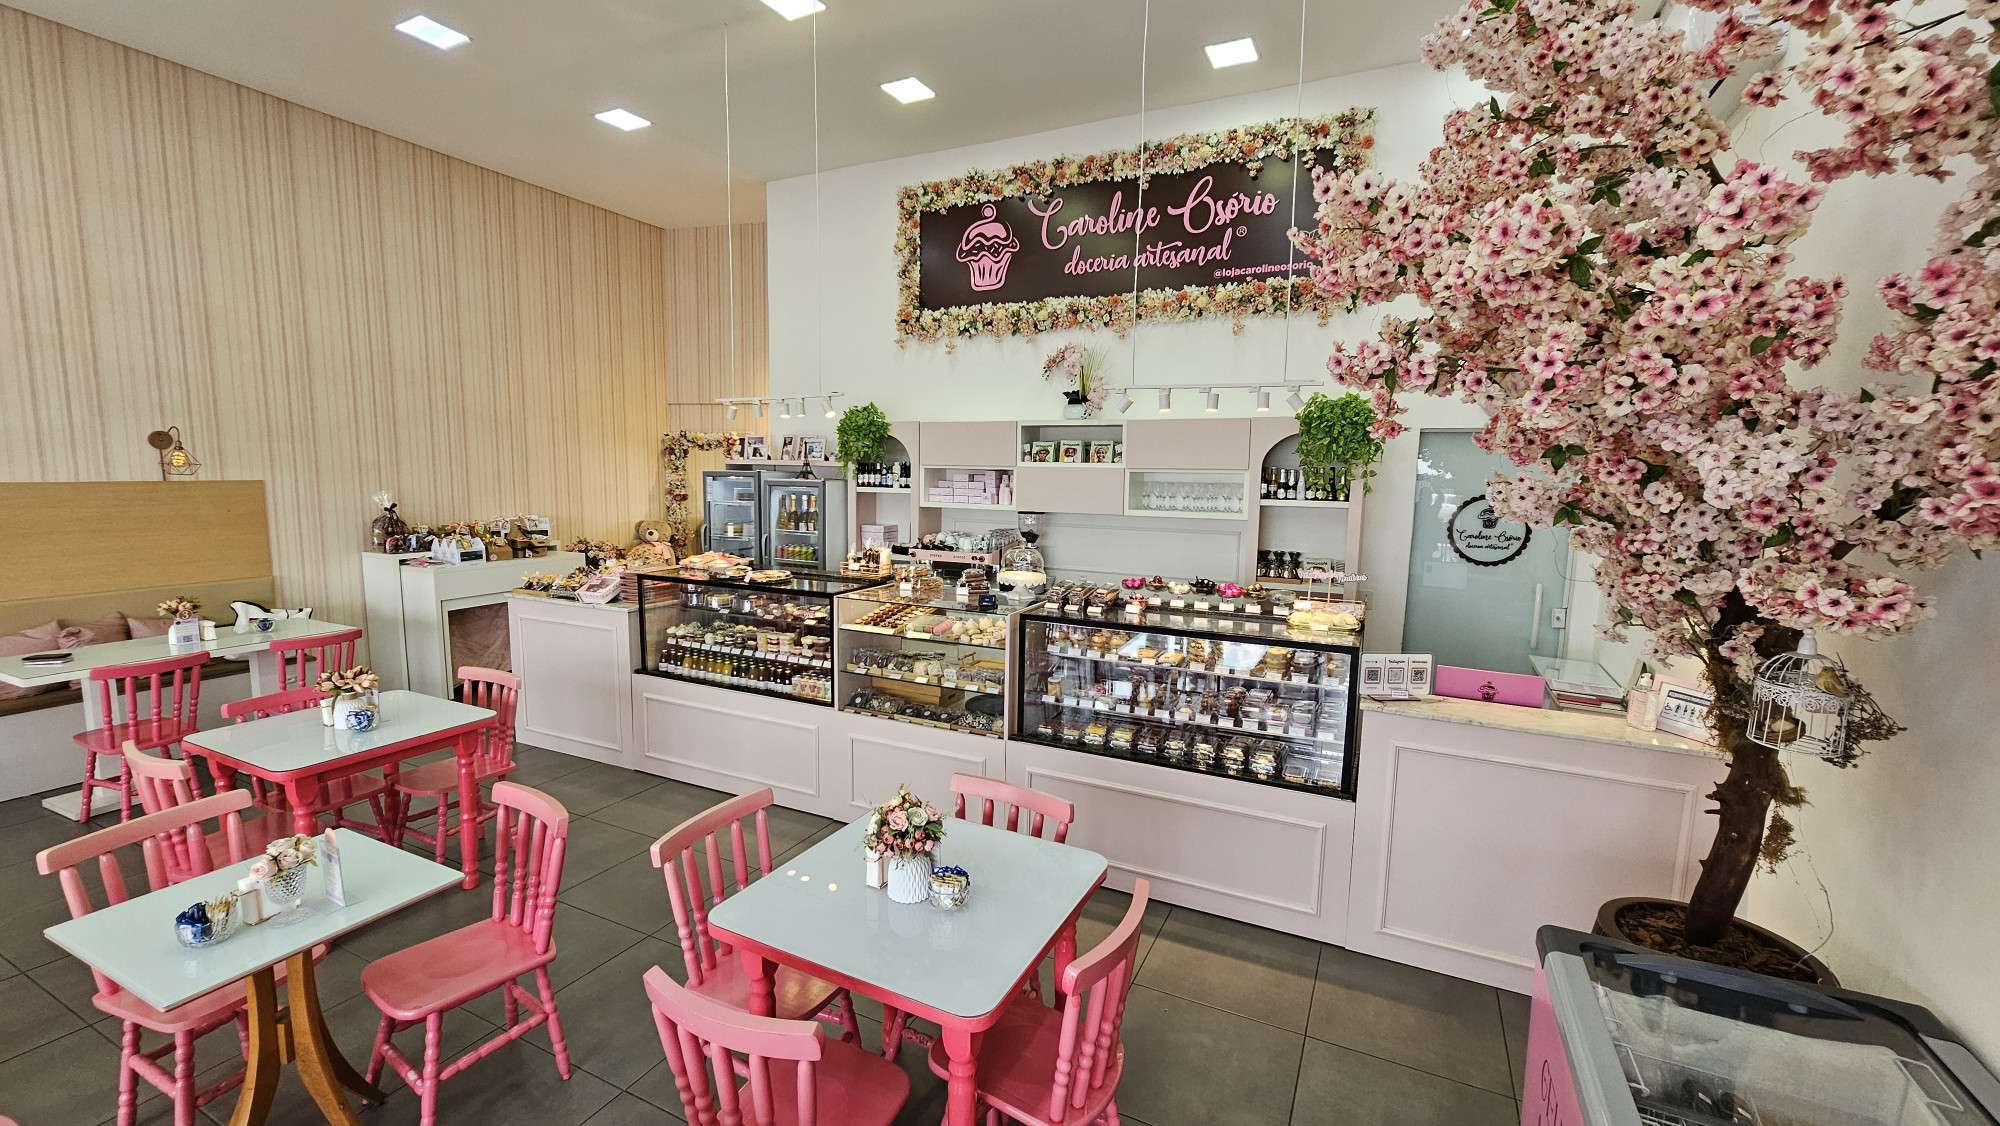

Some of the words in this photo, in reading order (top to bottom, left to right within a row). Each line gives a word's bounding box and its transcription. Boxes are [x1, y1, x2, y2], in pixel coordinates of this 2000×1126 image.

[1027, 191, 1160, 249] Caroline
[1167, 175, 1279, 234] Osório
[1064, 245, 1130, 276] doceria
